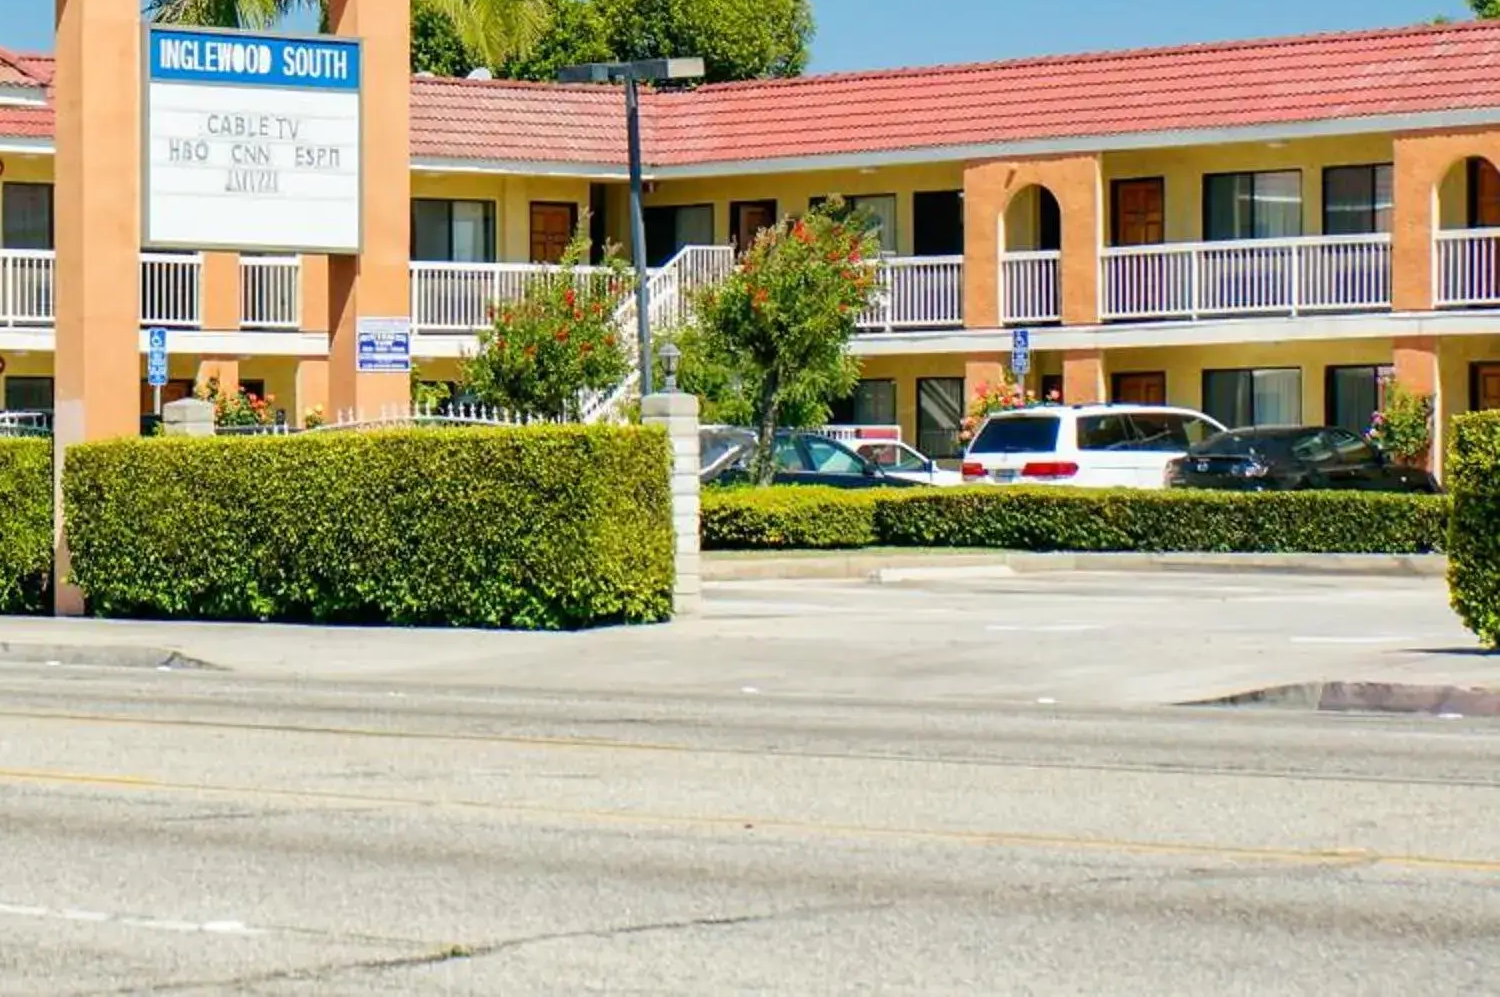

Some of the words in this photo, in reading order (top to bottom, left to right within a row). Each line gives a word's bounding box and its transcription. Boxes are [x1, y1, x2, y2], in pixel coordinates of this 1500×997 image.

[159, 38, 272, 74] INGLEWOOD
[282, 46, 347, 79] SOUTH
[207, 114, 269, 137] CABLE
[276, 118, 299, 140] TV
[231, 144, 270, 164] CNN
